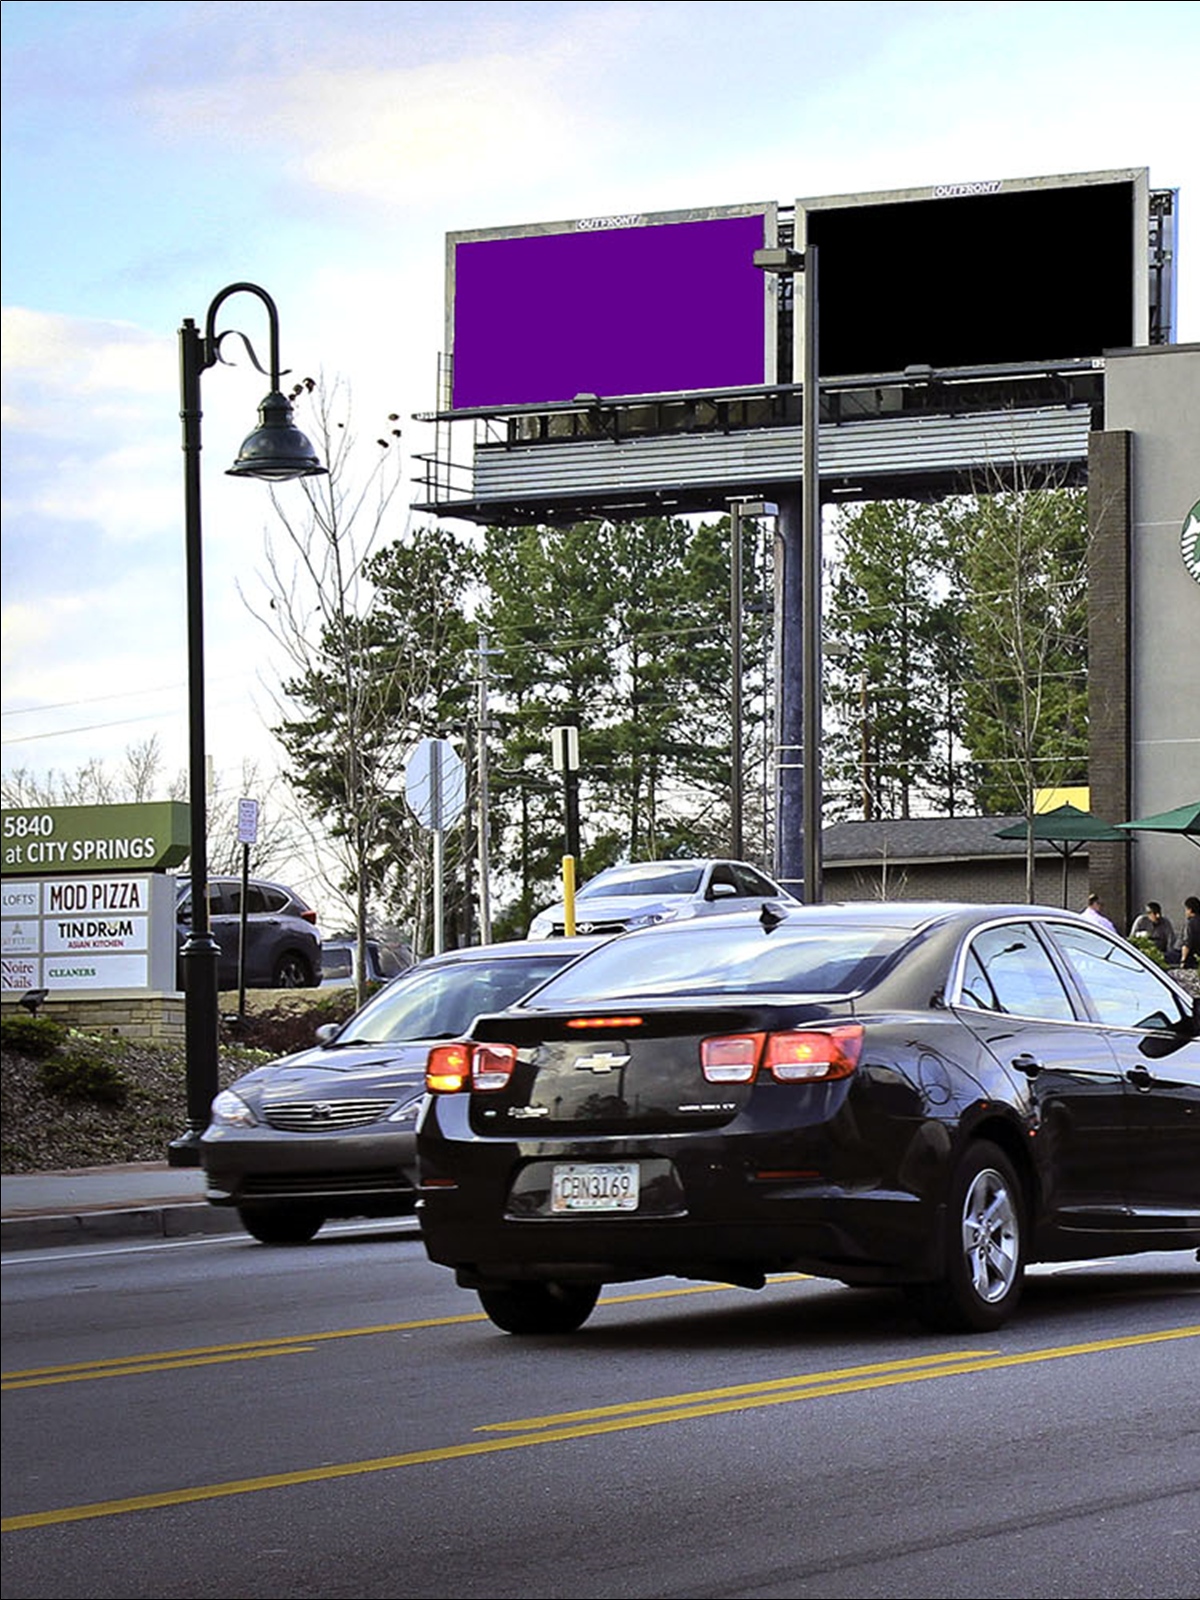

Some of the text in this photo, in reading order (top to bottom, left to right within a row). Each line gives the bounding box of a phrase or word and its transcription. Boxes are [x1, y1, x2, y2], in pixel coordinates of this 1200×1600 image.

[936, 181, 1000, 197] OUTFRONT
[3, 815, 53, 837] 5840
[6, 838, 155, 863] at CITY SPRINGS
[51, 883, 140, 911] MOD PIZZA
[1, 961, 34, 974] Noire
[49, 968, 96, 977] CLEANERS
[1, 976, 33, 988] Nails
[561, 1176, 630, 1198] CBN3169
